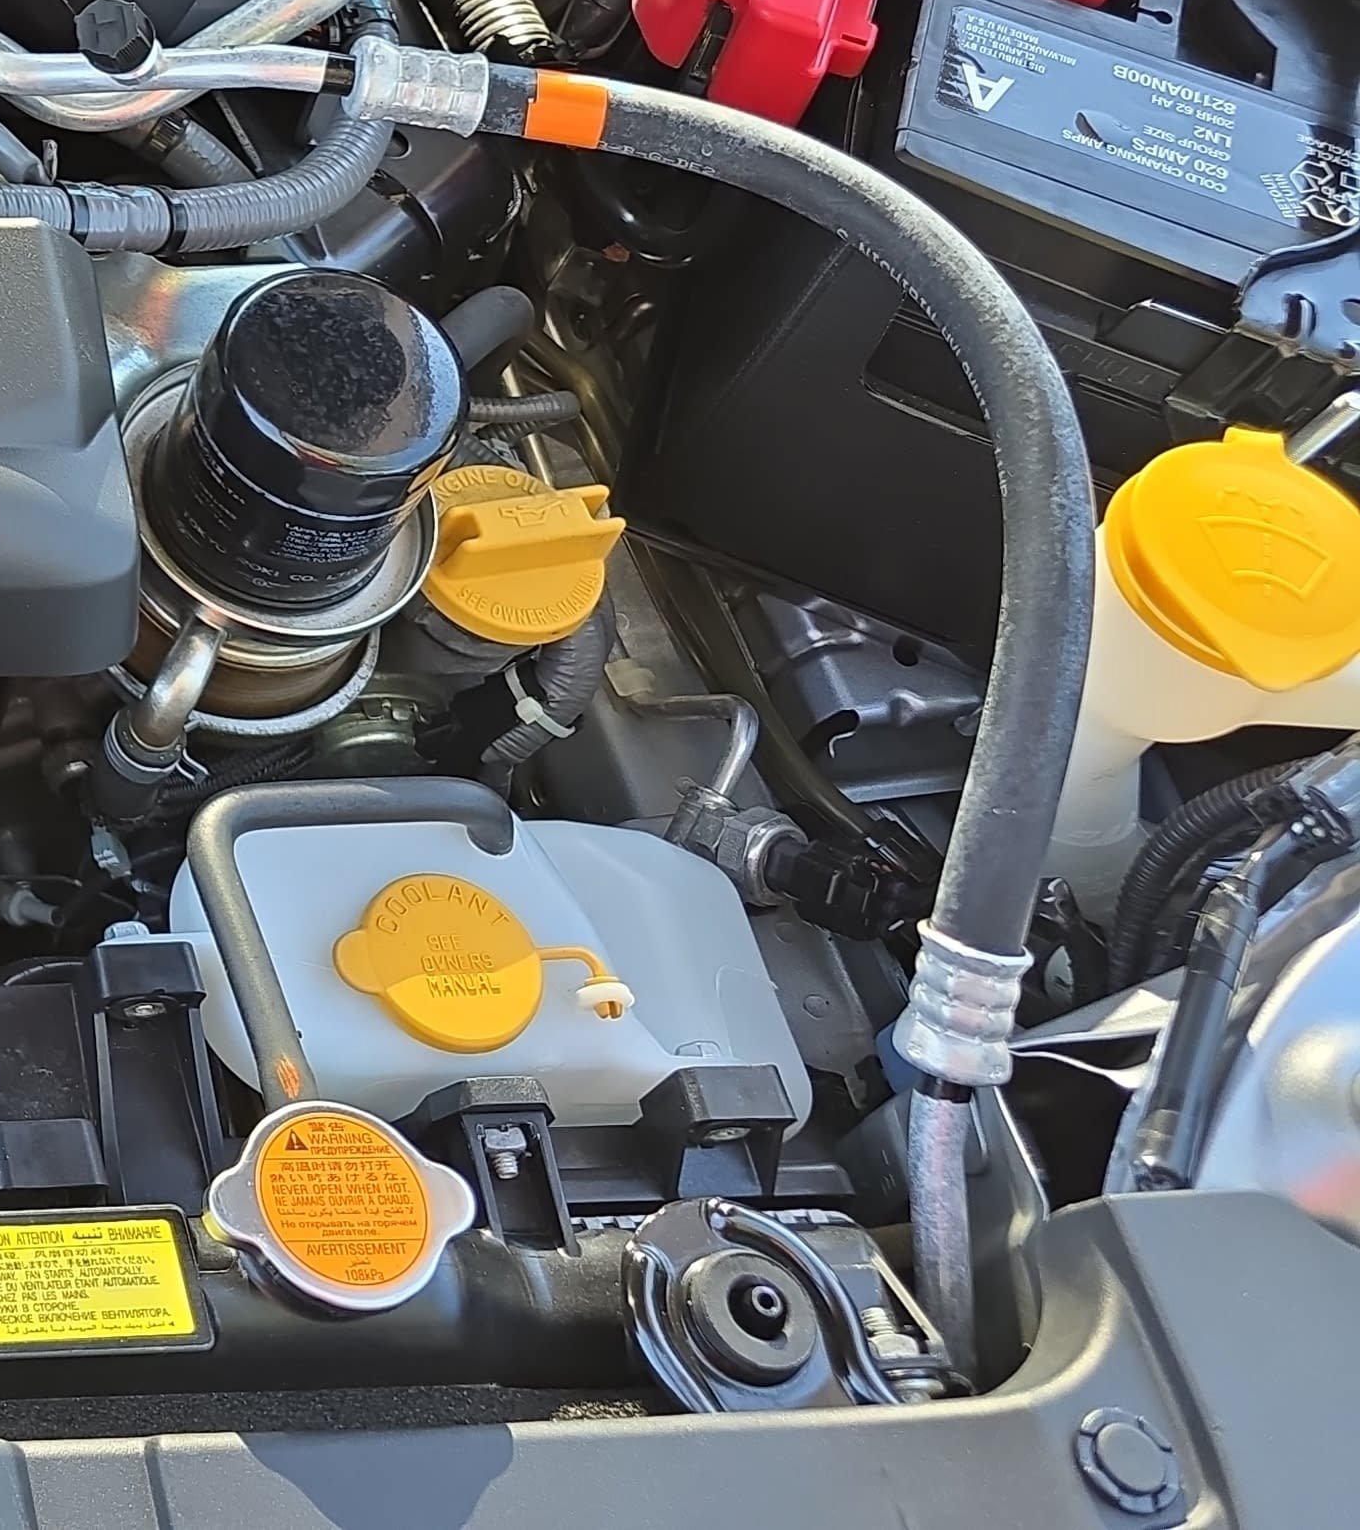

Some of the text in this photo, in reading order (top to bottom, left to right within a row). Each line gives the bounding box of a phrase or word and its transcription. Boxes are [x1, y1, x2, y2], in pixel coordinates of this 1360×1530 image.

[980, 45, 1047, 74] DISTRIBUTED
[962, 62, 1016, 112] A
[1112, 64, 1238, 116] 82110AN00B
[1151, 94, 1236, 130] 20HR 62 AH
[1143, 124, 1231, 162] GROUP SIZE
[1193, 125, 1233, 149] LN2
[1062, 128, 1228, 193] COLD CRANKING AMPS
[1132, 137, 1230, 180] 620 AMPS
[1260, 174, 1297, 217] RETOUR
[1271, 173, 1309, 217] RETURN
[435, 469, 544, 506] NGINE OIL
[457, 571, 601, 625] SEE OWNER'S MANUAL
[376, 882, 509, 935] COOLANT
[427, 934, 464, 951] SEE
[426, 974, 501, 998] MANUAL
[307, 1133, 373, 1144] WARNING
[310, 1145, 392, 1155] ПРЕДУПРЕЖДЕНИЕ
[272, 1182, 411, 1195] NEVER OPEN WHEN HOT.
[275, 1197, 288, 1206] NE
[291, 1196, 325, 1206] JAMAIS
[329, 1195, 364, 1205] OUVRIR
[108, 1226, 162, 1240] ВНИМАНИЕ
[281, 1220, 296, 1228] Не
[299, 1221, 354, 1230] открывать
[373, 1220, 417, 1228] горячем
[16, 1230, 65, 1246] ATTENTION
[307, 1242, 407, 1256] AVERTISSEMENT
[25, 1271, 41, 1280] FAN
[45, 1268, 74, 1278] STARTS
[344, 1268, 385, 1281] 108kPa
[5, 1282, 18, 1291] DU
[20, 1280, 72, 1291] VENTILATEUR
[22, 1293, 37, 1301] PAS
[42, 1291, 57, 1300] LES
[23, 1304, 29, 1312] В
[39, 1311, 97, 1323] ВКЛЮЧЕНИЕ
